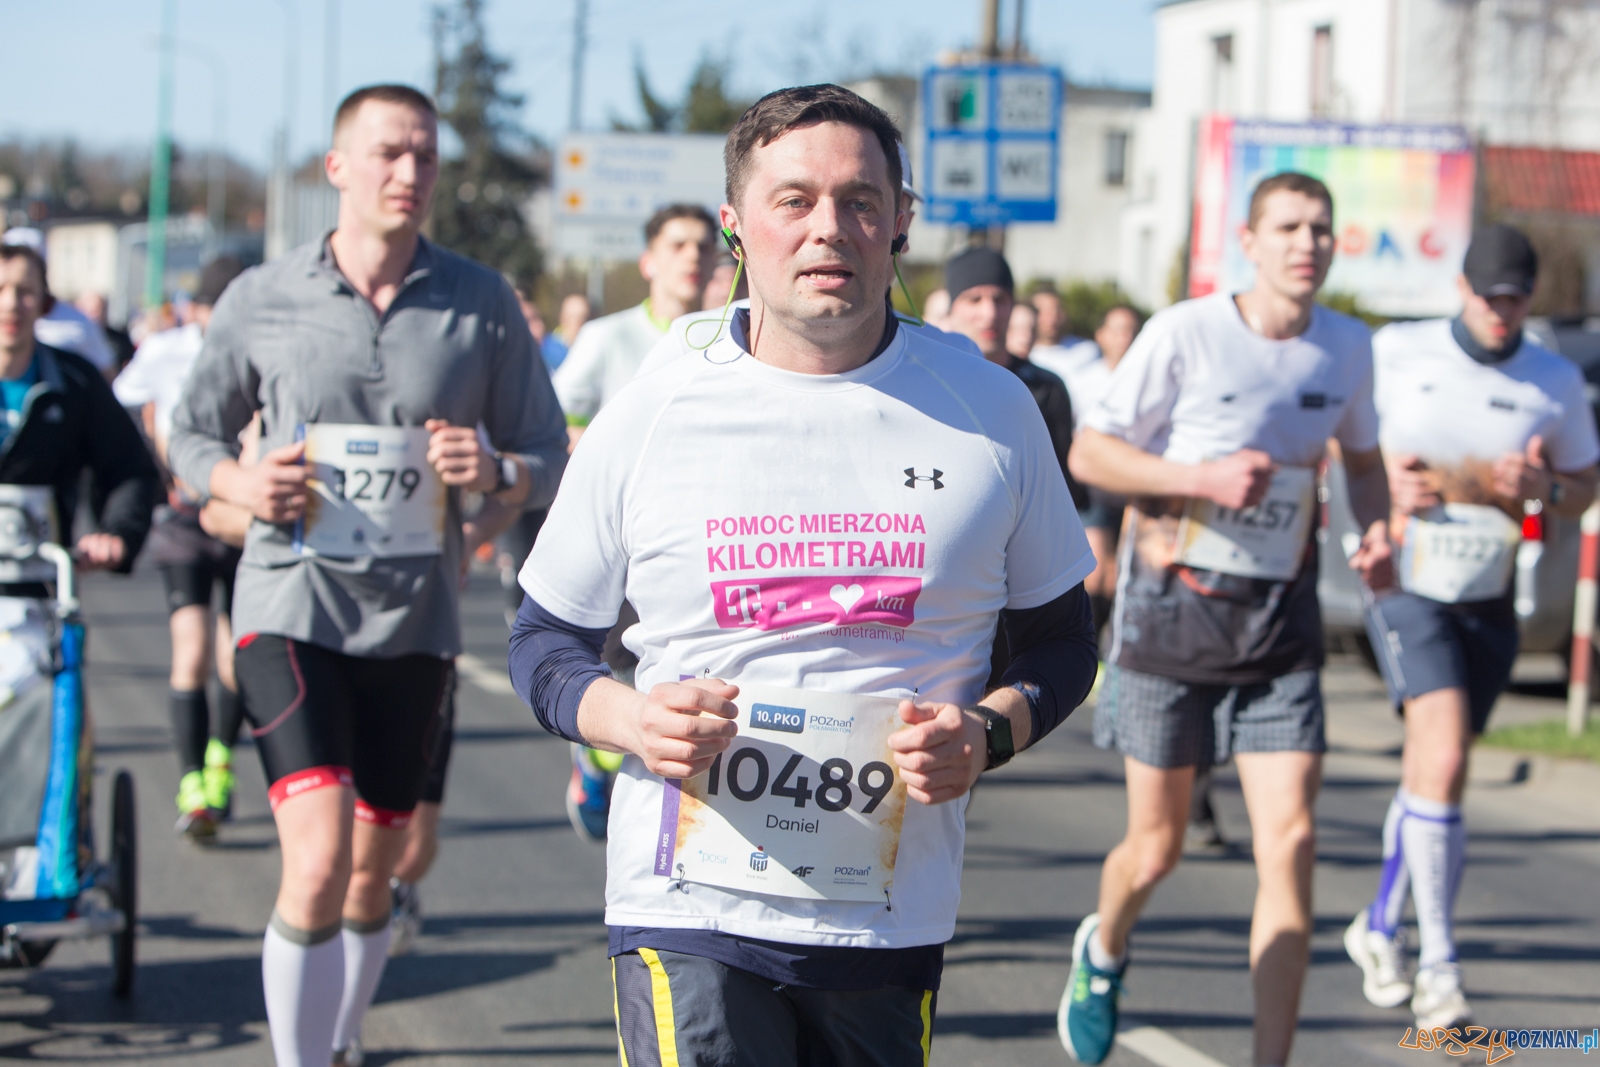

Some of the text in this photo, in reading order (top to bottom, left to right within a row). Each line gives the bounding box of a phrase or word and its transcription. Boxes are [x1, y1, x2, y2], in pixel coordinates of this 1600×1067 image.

[706, 513, 927, 538] POMOC MIERZONA
[706, 541, 926, 573] KILOMETRAMI
[874, 590, 906, 611] km
[756, 710, 772, 724] 10.
[773, 712, 800, 727] PKO
[707, 746, 894, 814] 10489
[766, 814, 819, 834] Daniel
